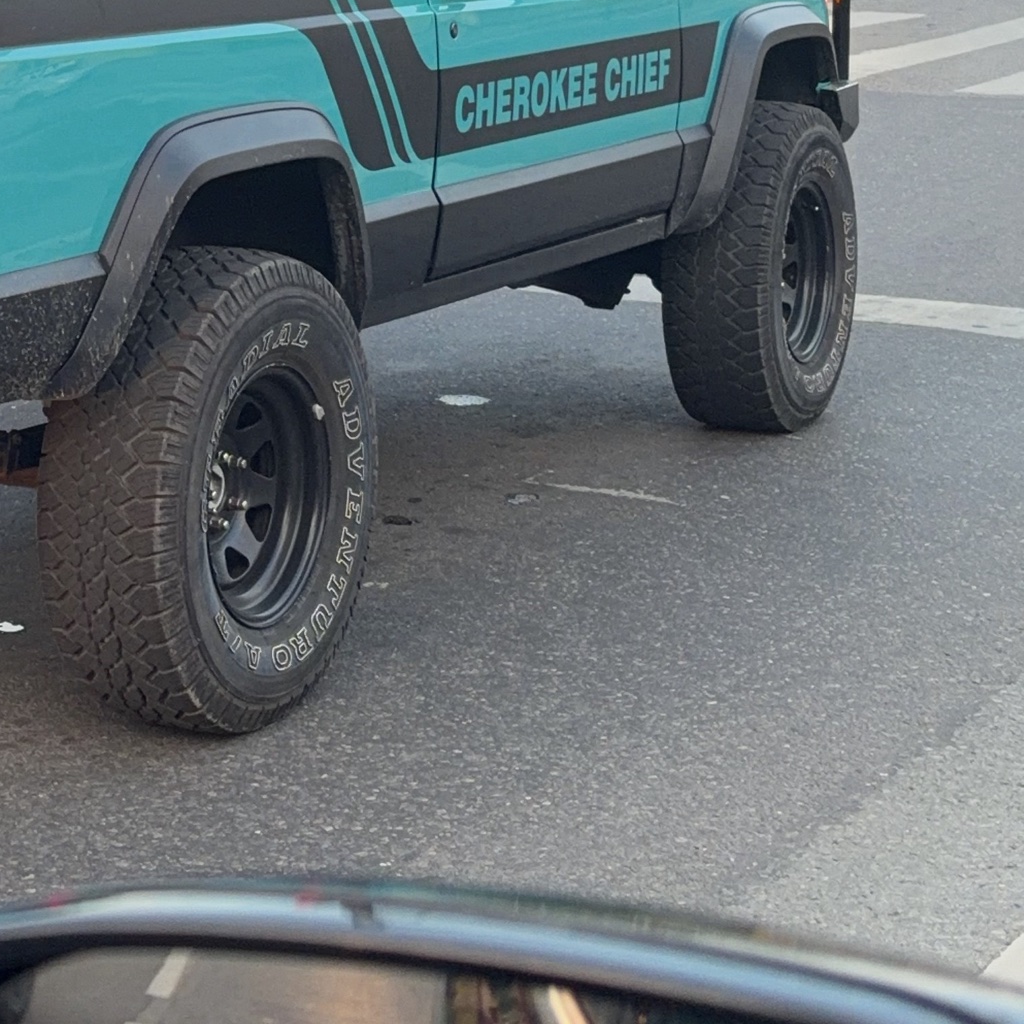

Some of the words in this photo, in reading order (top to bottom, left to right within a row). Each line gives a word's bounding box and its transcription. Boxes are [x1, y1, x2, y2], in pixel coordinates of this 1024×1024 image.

[454, 61, 599, 134] CHEROKEE
[604, 47, 672, 102] CHIEF
[270, 377, 366, 671] ADVENTURO
